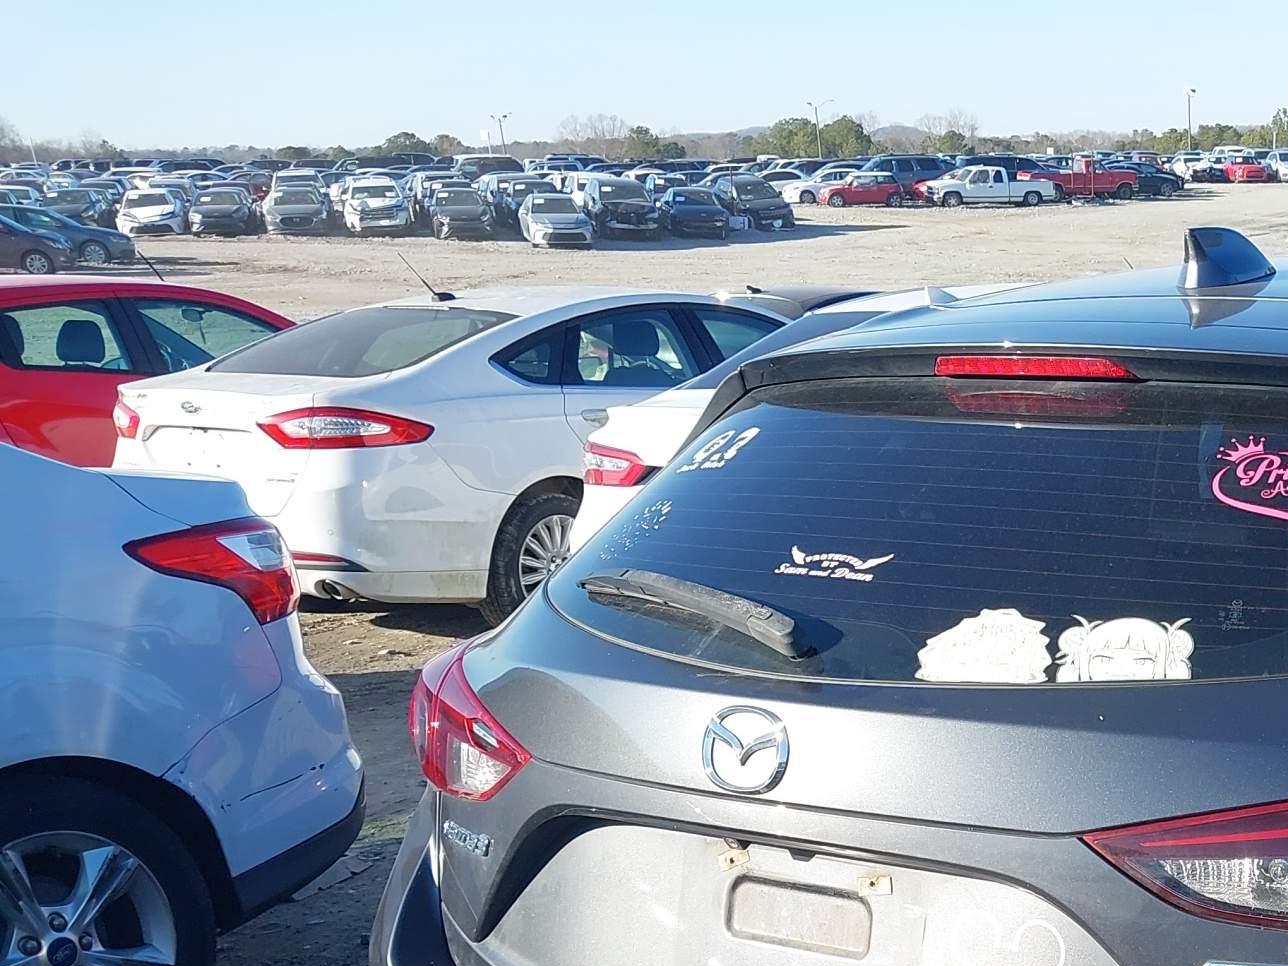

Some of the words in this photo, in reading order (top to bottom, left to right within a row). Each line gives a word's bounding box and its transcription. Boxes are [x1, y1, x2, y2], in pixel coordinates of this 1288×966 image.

[774, 563, 809, 575] Sam
[808, 569, 832, 577] and
[830, 567, 874, 582] Dean
